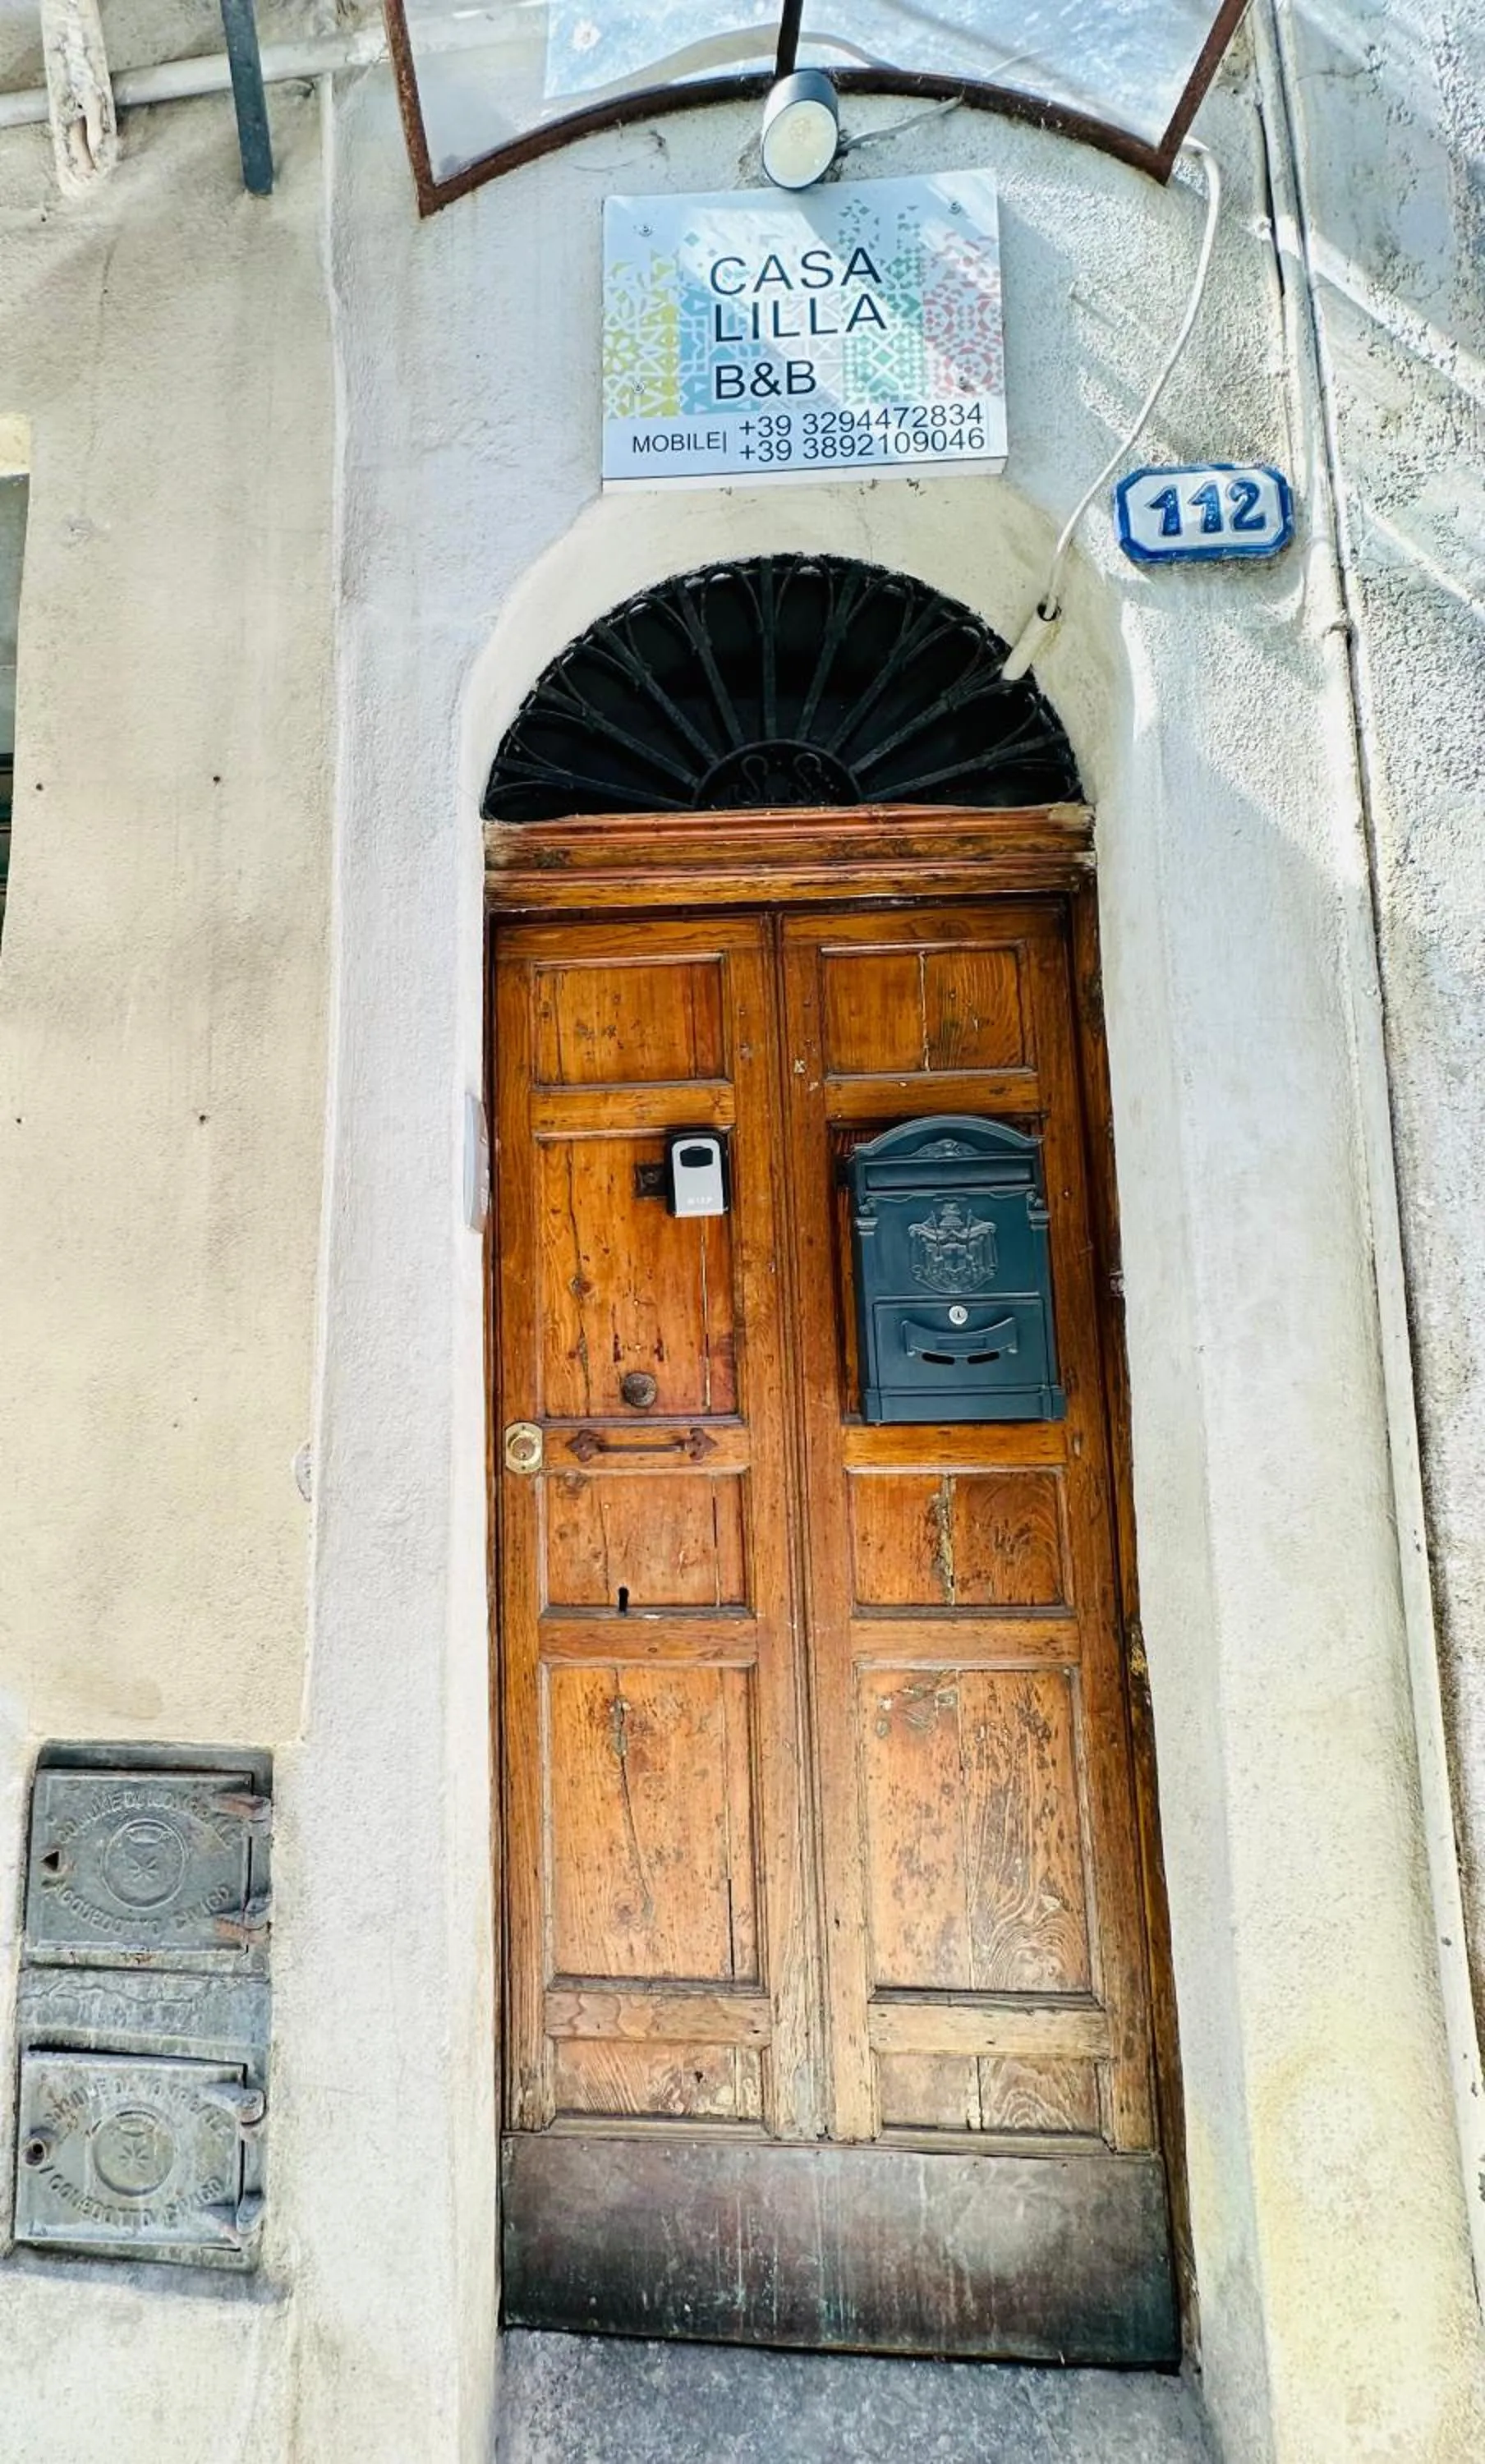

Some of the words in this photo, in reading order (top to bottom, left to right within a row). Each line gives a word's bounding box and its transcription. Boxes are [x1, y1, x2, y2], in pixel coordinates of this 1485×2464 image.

[710, 247, 882, 296] CASA
[714, 293, 887, 342] LILLA
[714, 360, 816, 400] B&B
[738, 415, 793, 438] +39
[802, 402, 983, 434] 3294472834
[738, 439, 793, 462] +39
[802, 427, 986, 460] 3892109046
[1149, 478, 1267, 536] 112
